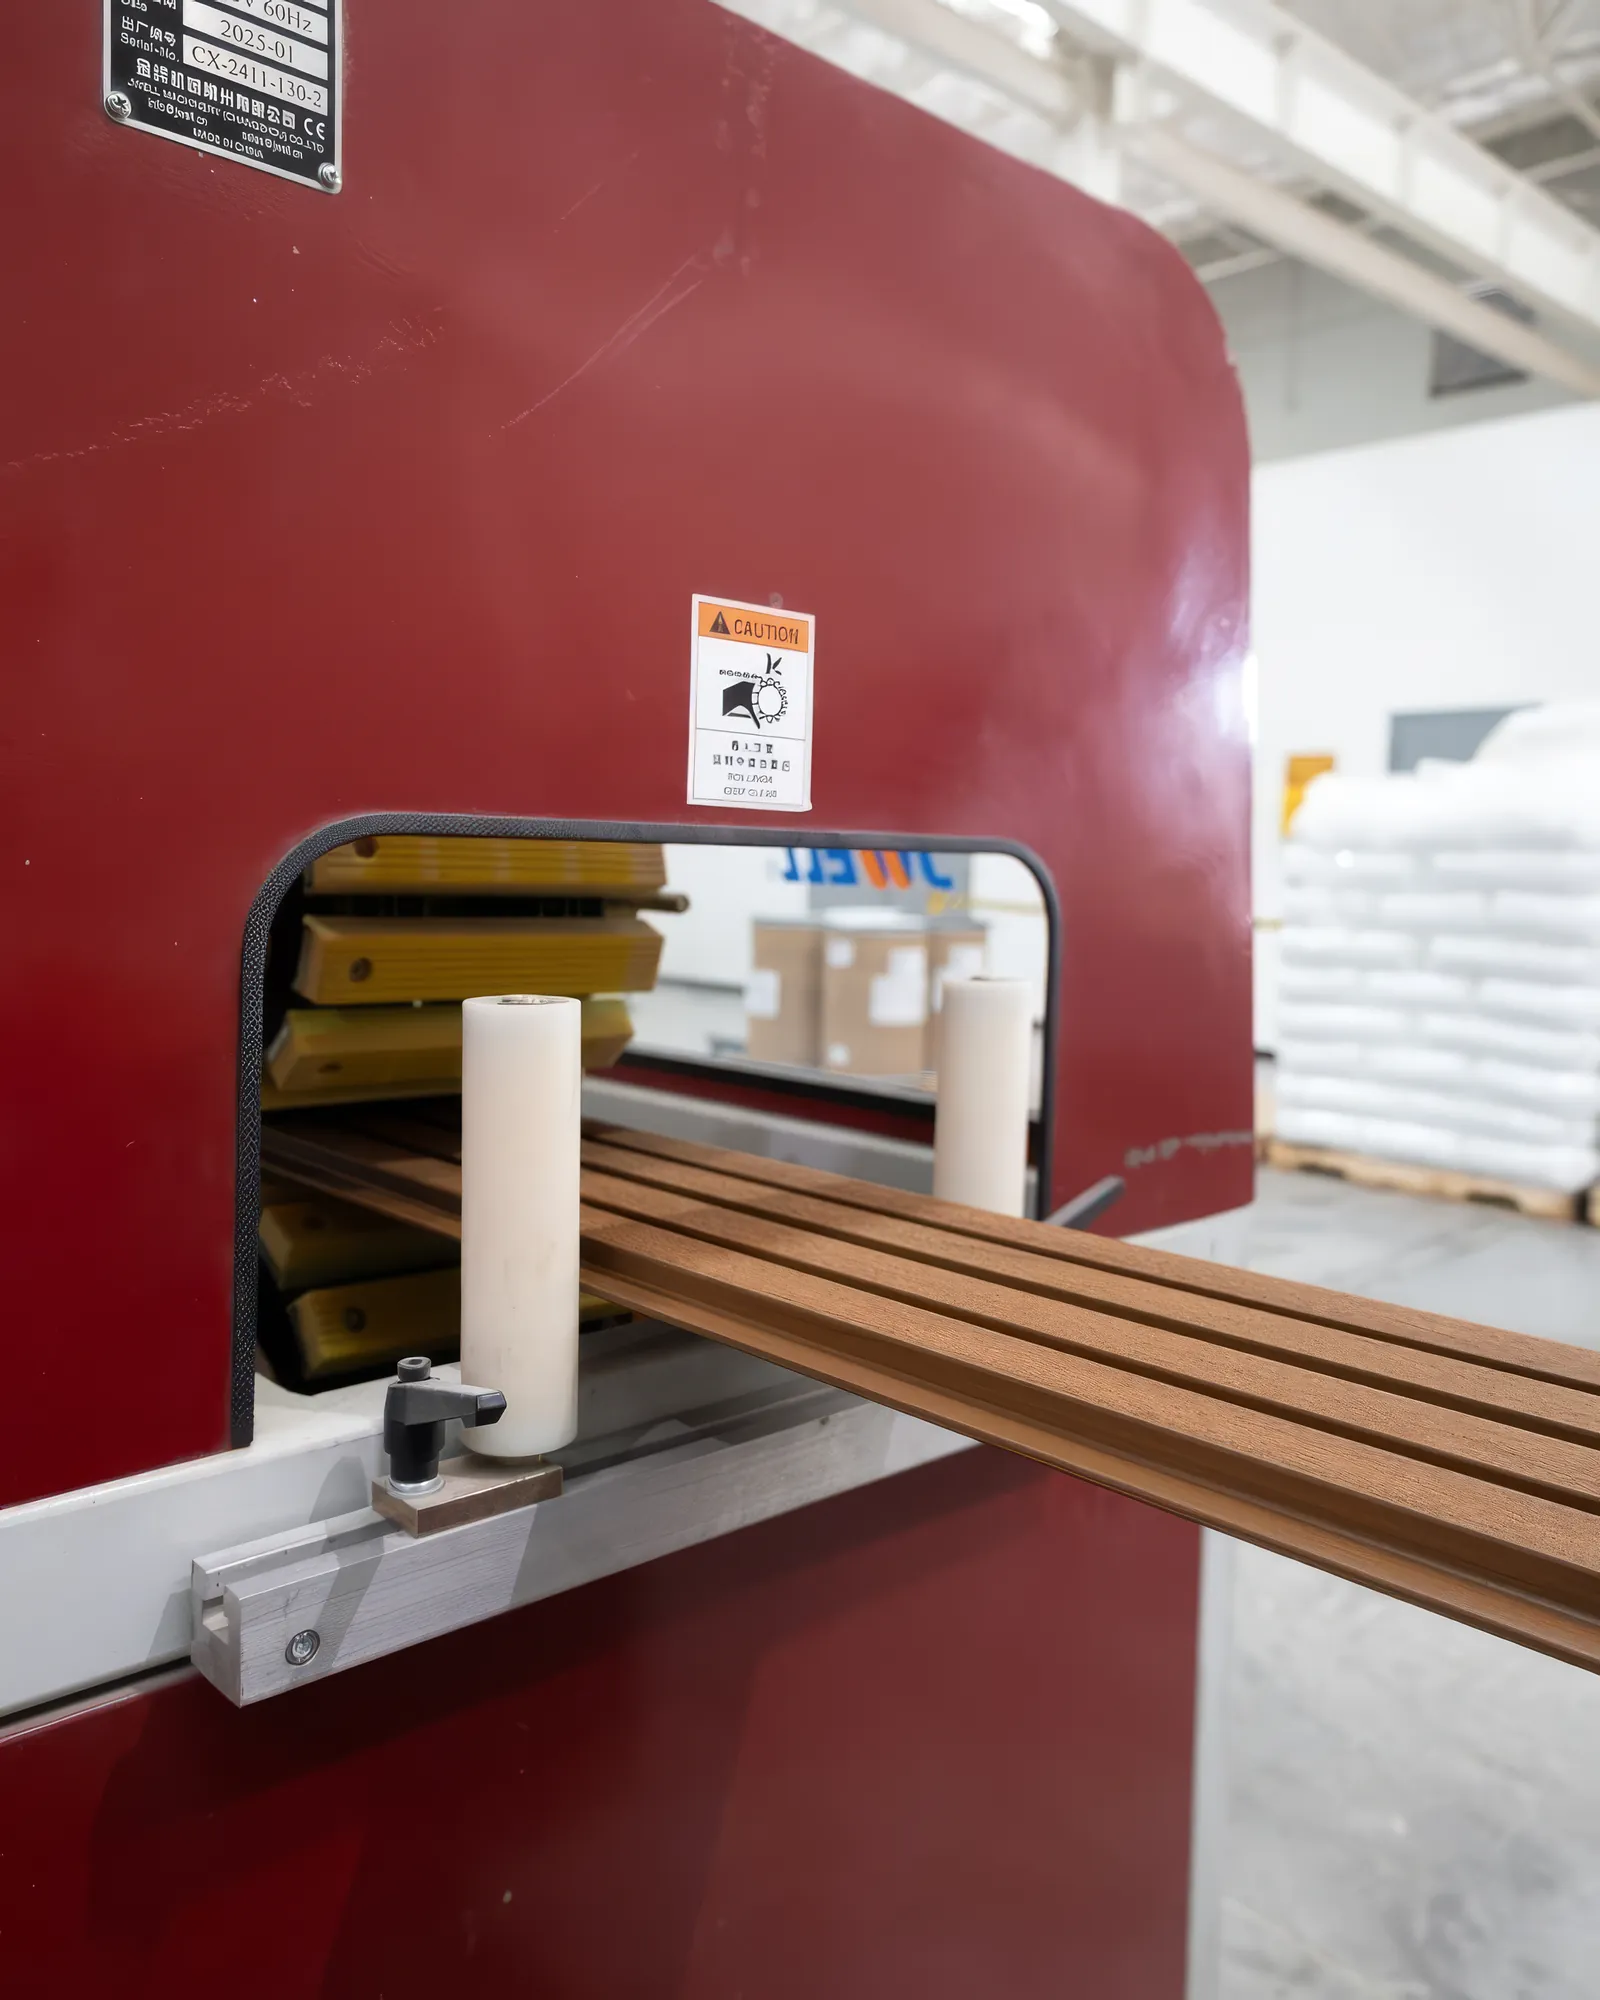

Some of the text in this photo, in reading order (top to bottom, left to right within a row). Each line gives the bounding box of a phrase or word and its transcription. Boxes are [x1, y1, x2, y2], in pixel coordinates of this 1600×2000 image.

[263, 0, 313, 33] 60Hz
[220, 19, 293, 64] 2025-01
[192, 45, 322, 108] CX-2411-130-2
[734, 619, 800, 645] CAUTION
